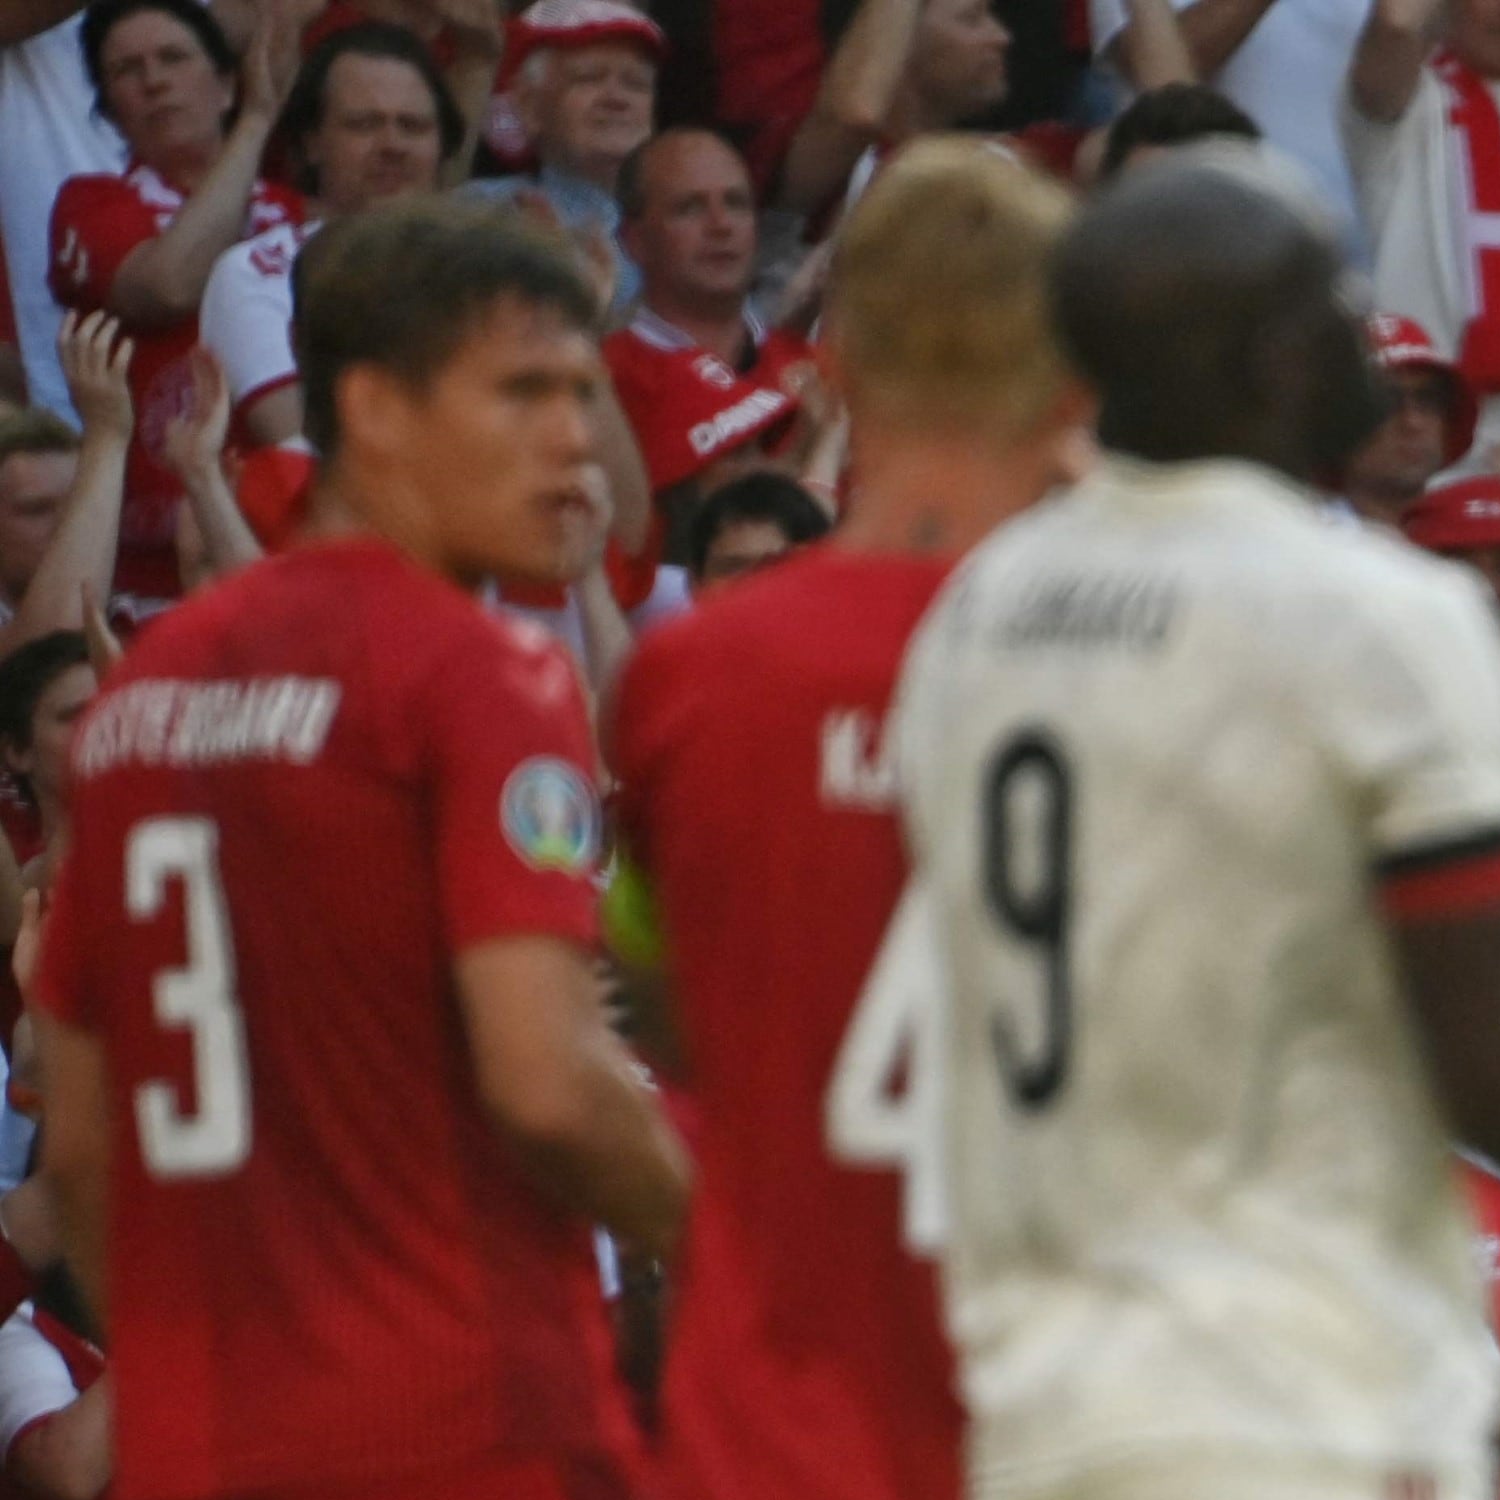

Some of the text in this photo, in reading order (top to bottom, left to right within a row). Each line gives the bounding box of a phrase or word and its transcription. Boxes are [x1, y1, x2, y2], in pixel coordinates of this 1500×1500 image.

[123, 814, 252, 1180] 3
[823, 880, 948, 1255] 4
[985, 722, 1070, 1113] 9
